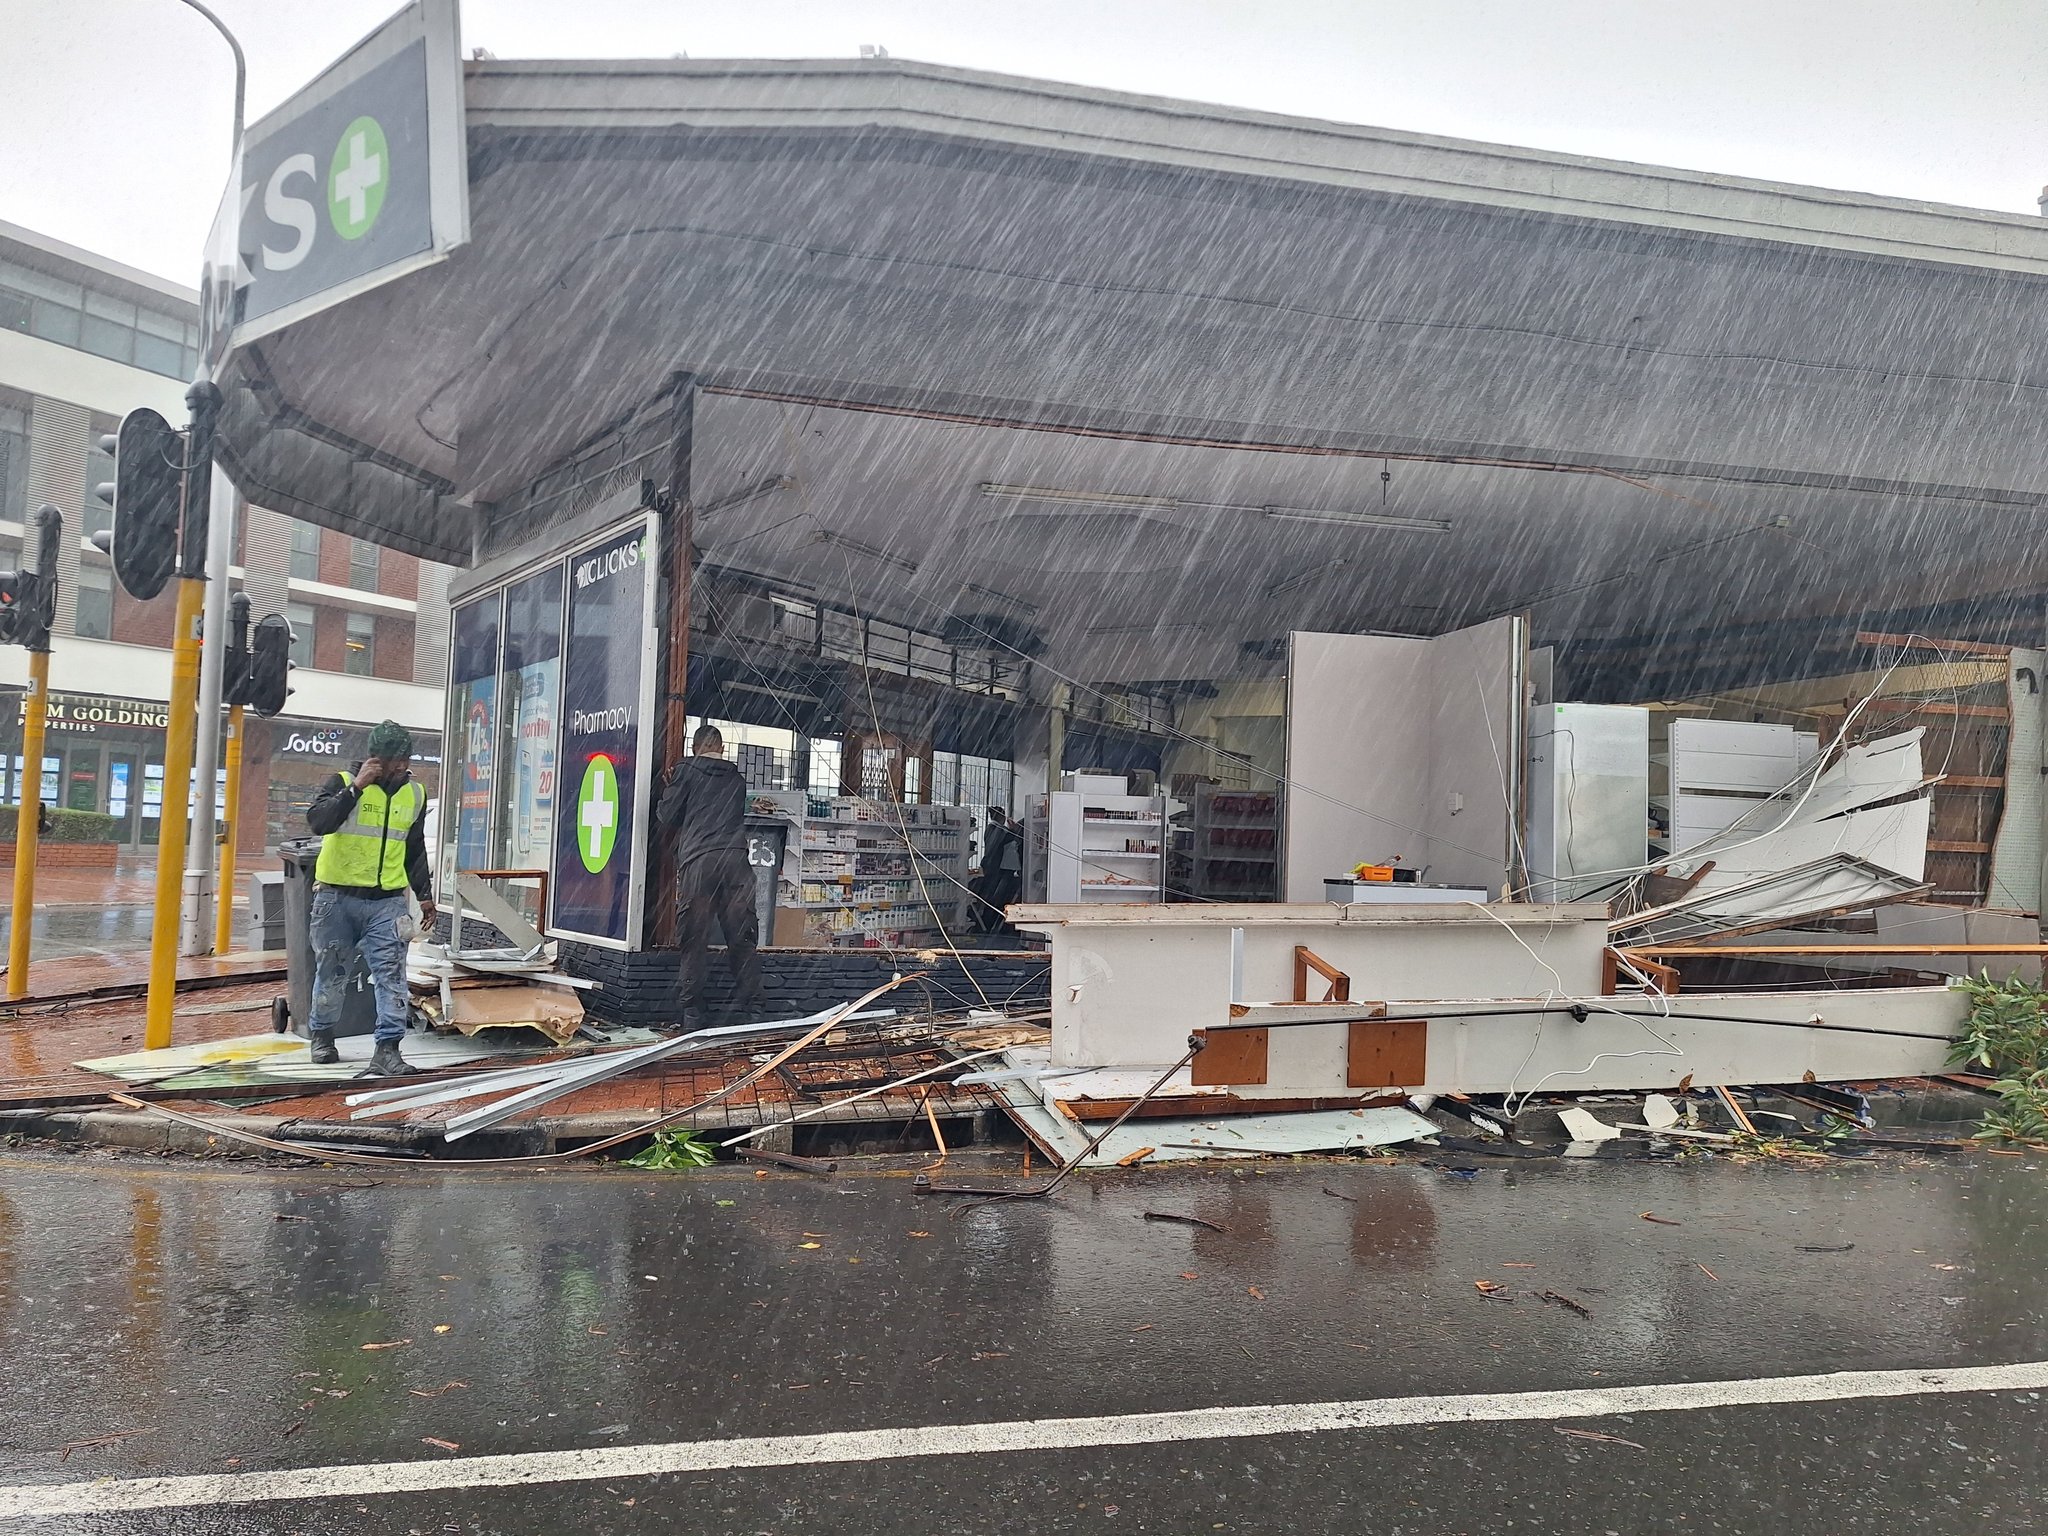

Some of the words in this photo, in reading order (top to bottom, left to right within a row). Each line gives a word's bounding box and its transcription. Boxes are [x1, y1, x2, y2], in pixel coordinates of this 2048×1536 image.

[587, 540, 639, 584] CLICKS
[17, 717, 96, 732] PPERTIES
[73, 706, 169, 728] GOLDING
[573, 705, 632, 737] Pharmacy
